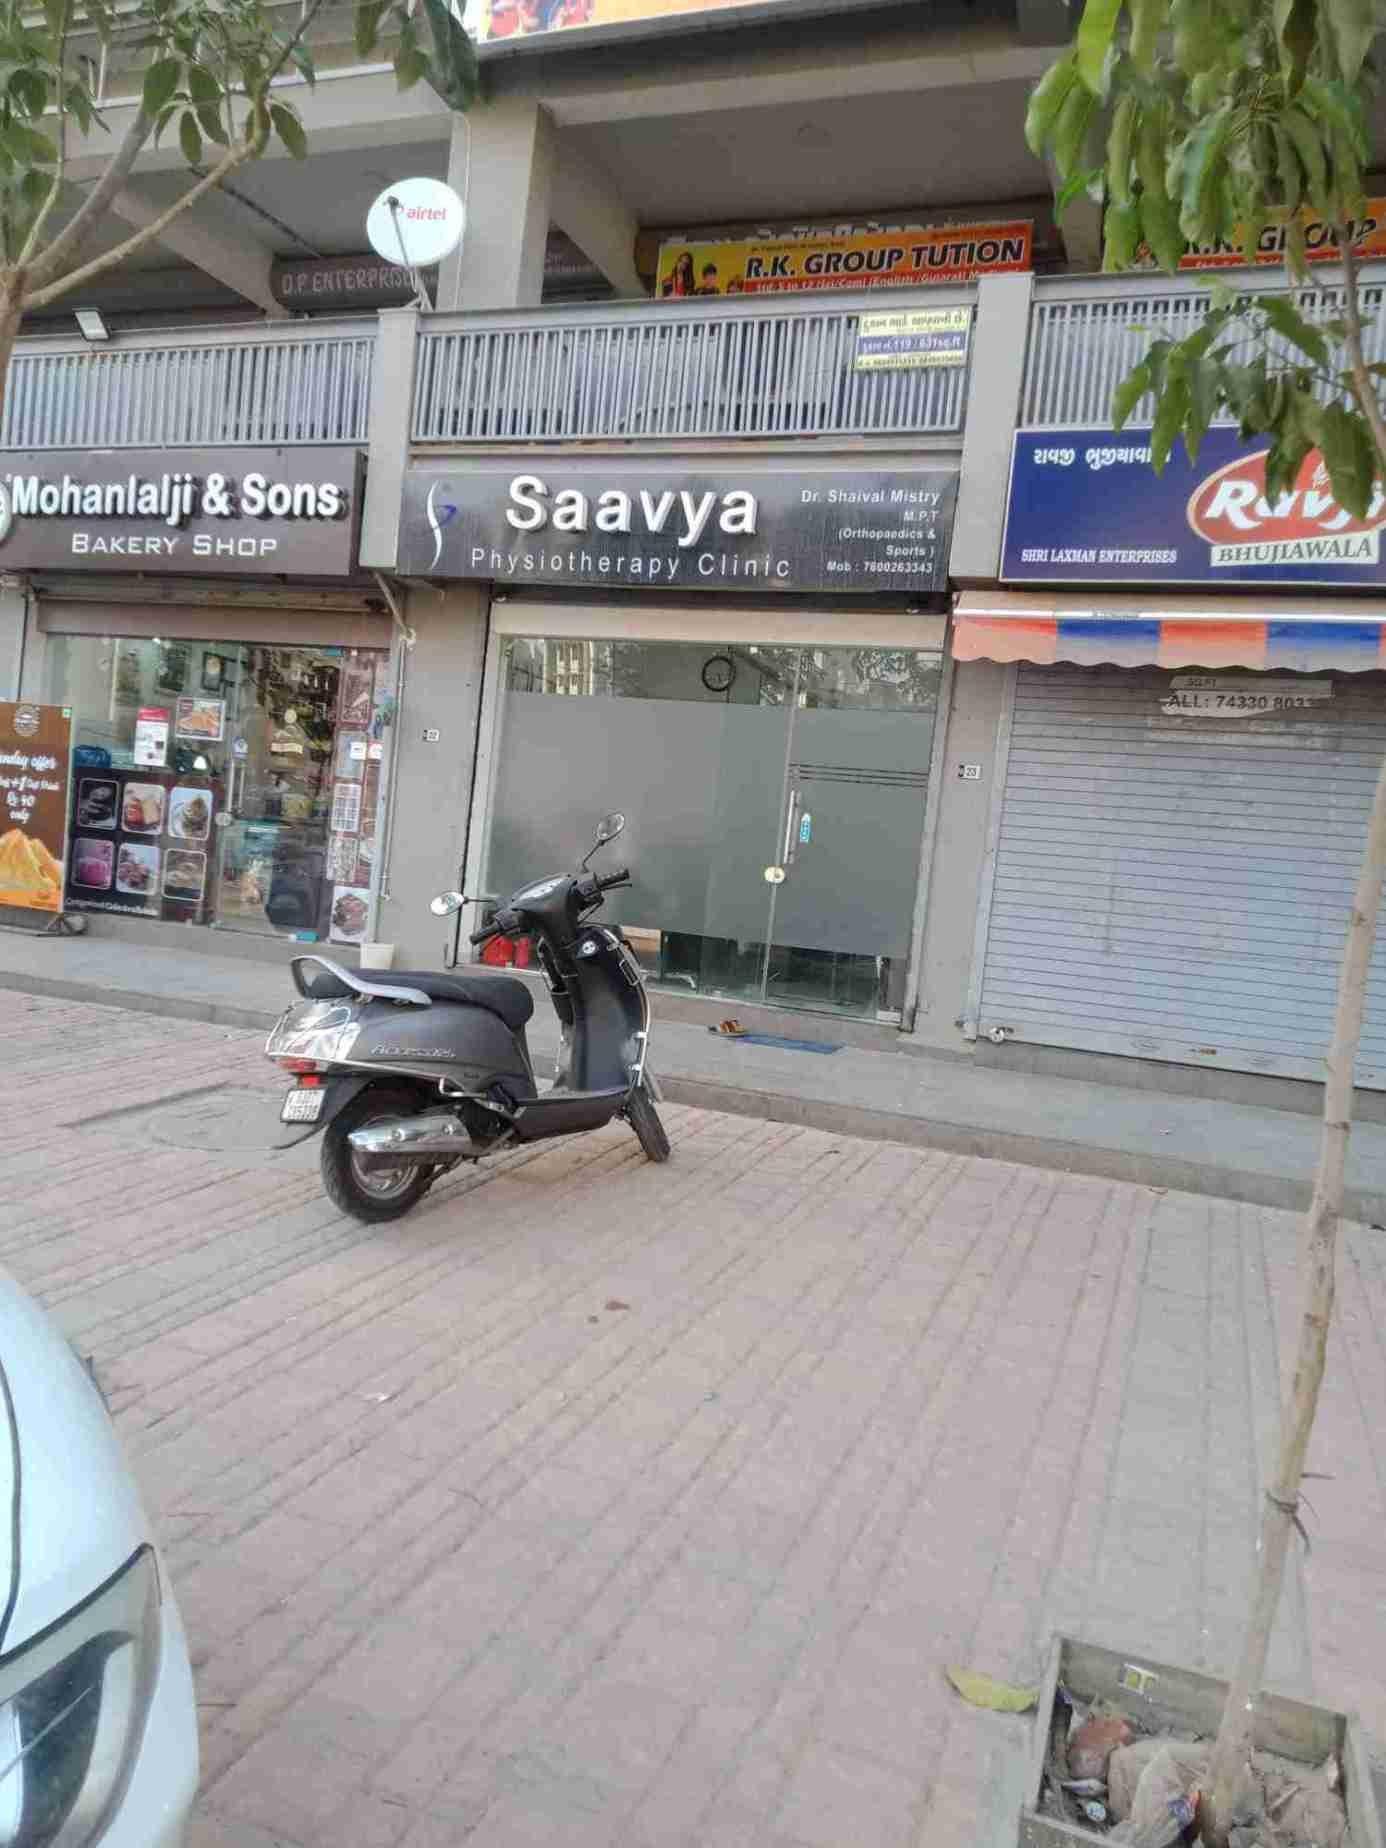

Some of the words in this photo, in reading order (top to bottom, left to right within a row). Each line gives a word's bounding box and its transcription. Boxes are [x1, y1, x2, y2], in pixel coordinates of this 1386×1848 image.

[406, 206, 448, 221] airtel
[745, 254, 796, 279] R.K.
[803, 247, 904, 275] GROUP
[911, 239, 1024, 270] TUTION
[12, 473, 193, 528] Mohanlalji
[202, 472, 231, 516] &
[241, 472, 341, 517] Sons
[800, 488, 821, 503] Dr.
[890, 488, 941, 506] Mistry
[505, 474, 758, 548] Saavya
[71, 533, 179, 555] BAKERY
[192, 534, 278, 557] SHOP
[927, 528, 937, 540] &
[470, 547, 680, 577] Physiotherapy
[697, 552, 791, 578] Clinic
[1021, 548, 1048, 563] SHRI
[1049, 548, 1097, 563] LAXMAN
[1098, 549, 1178, 564] ENTERPRISES
[1217, 538, 1373, 563] BHUJIAWALA
